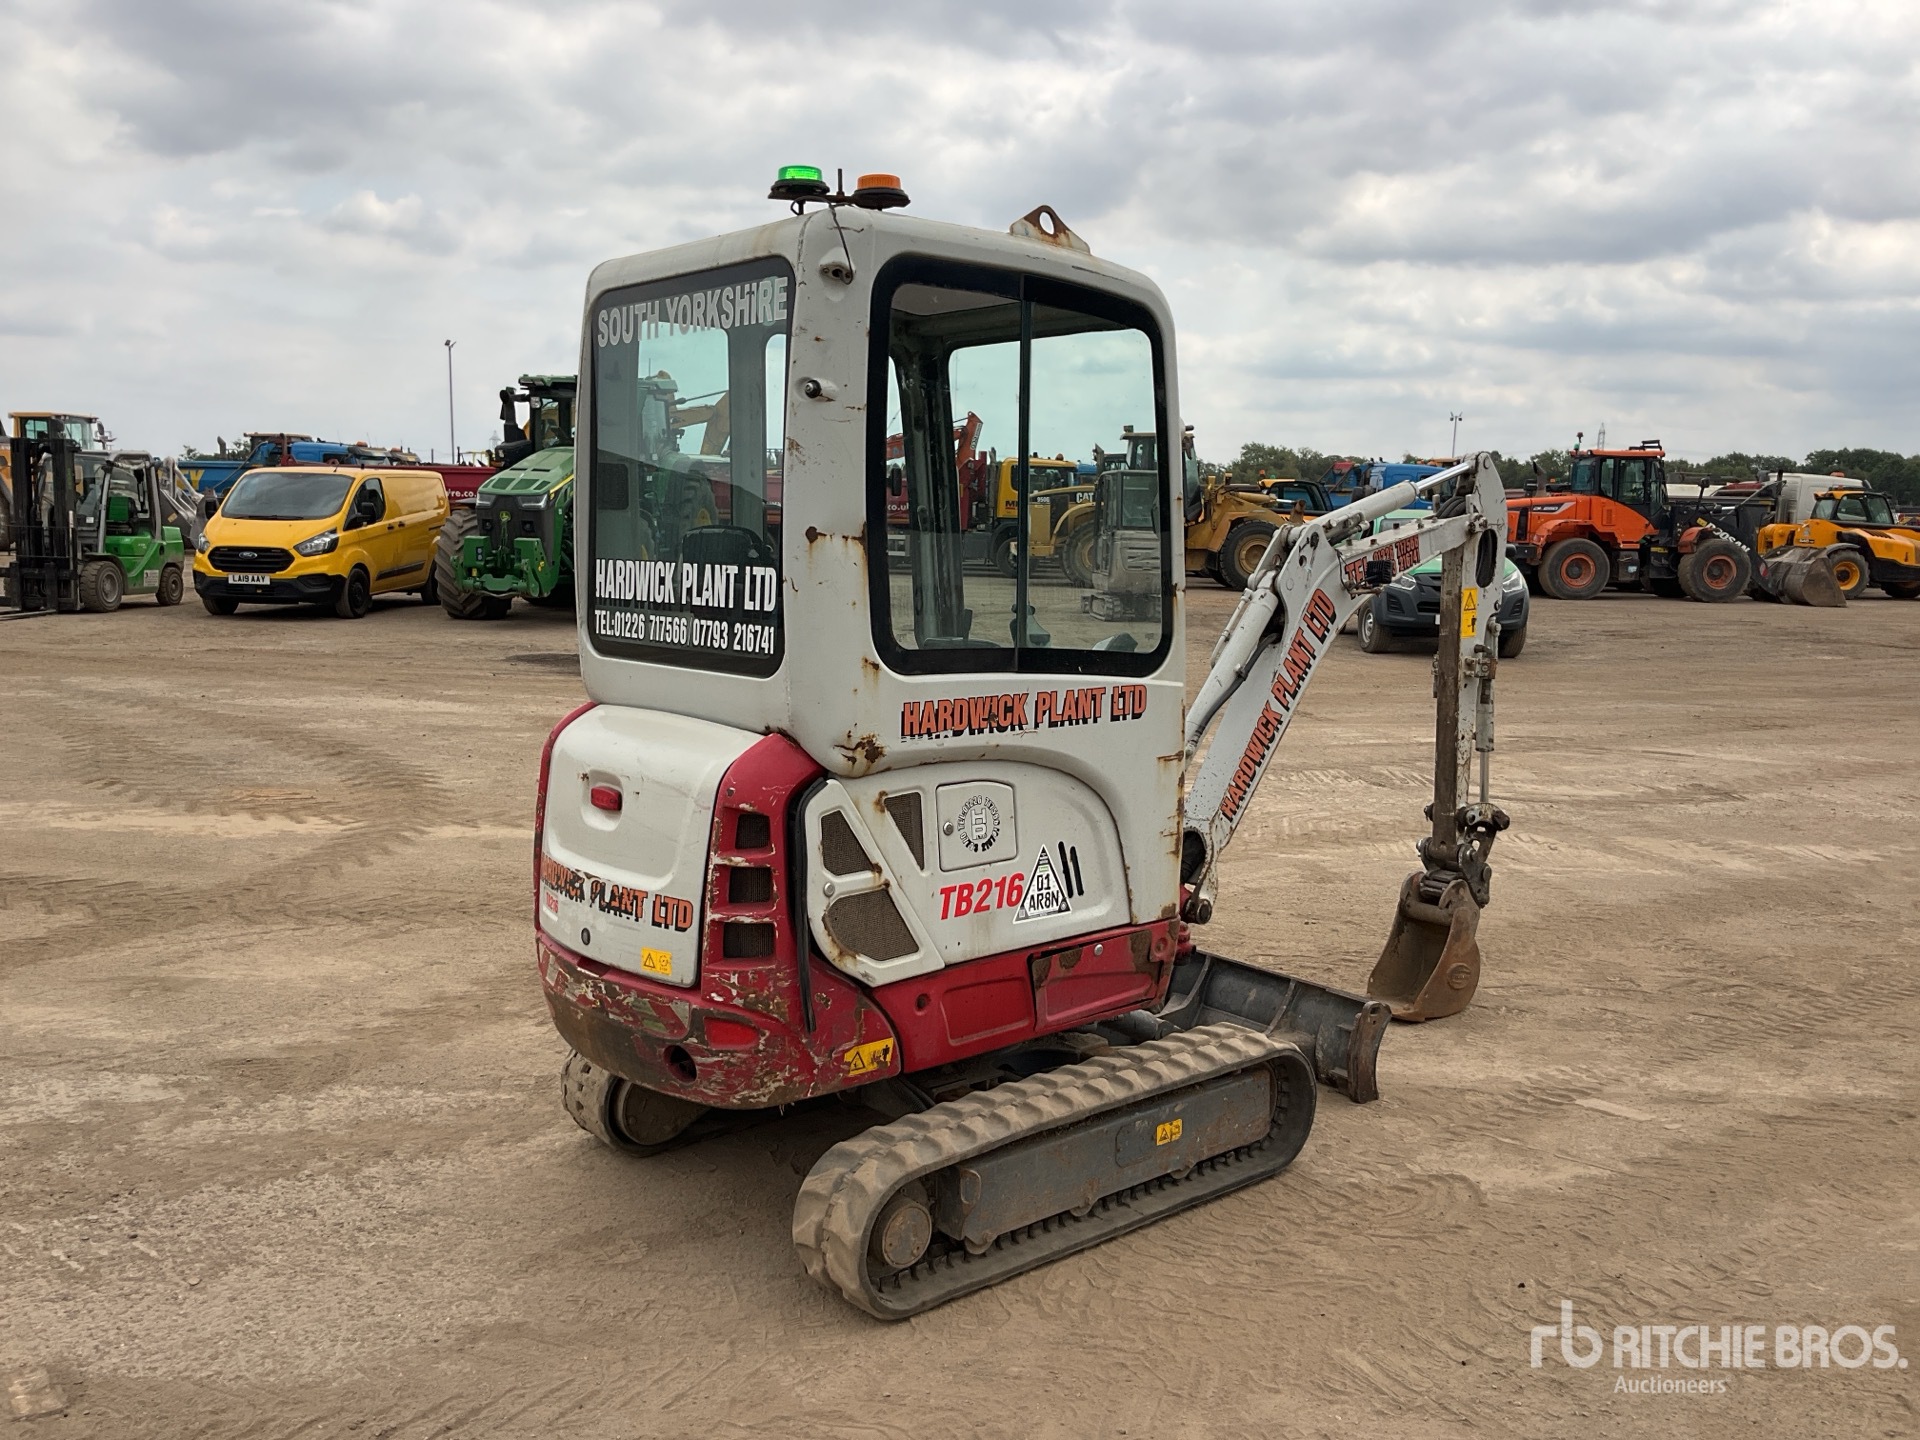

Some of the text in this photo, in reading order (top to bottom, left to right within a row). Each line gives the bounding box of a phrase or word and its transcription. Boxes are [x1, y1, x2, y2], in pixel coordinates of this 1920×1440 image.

[597, 276, 788, 348] SOUTH YORKSHIRE
[1076, 492, 1094, 504] CAT
[232, 574, 249, 583] LA19
[595, 559, 777, 612] HARDWICK PLANT LTD
[733, 622, 774, 655] 216741
[901, 684, 1147, 740] HARDWICK PLANT LTD
[1219, 588, 1337, 822] HARDWICK PLANT LTD
[652, 893, 693, 932] LTD
[939, 872, 1024, 920] TB216
[1028, 890, 1059, 912] AR8N
